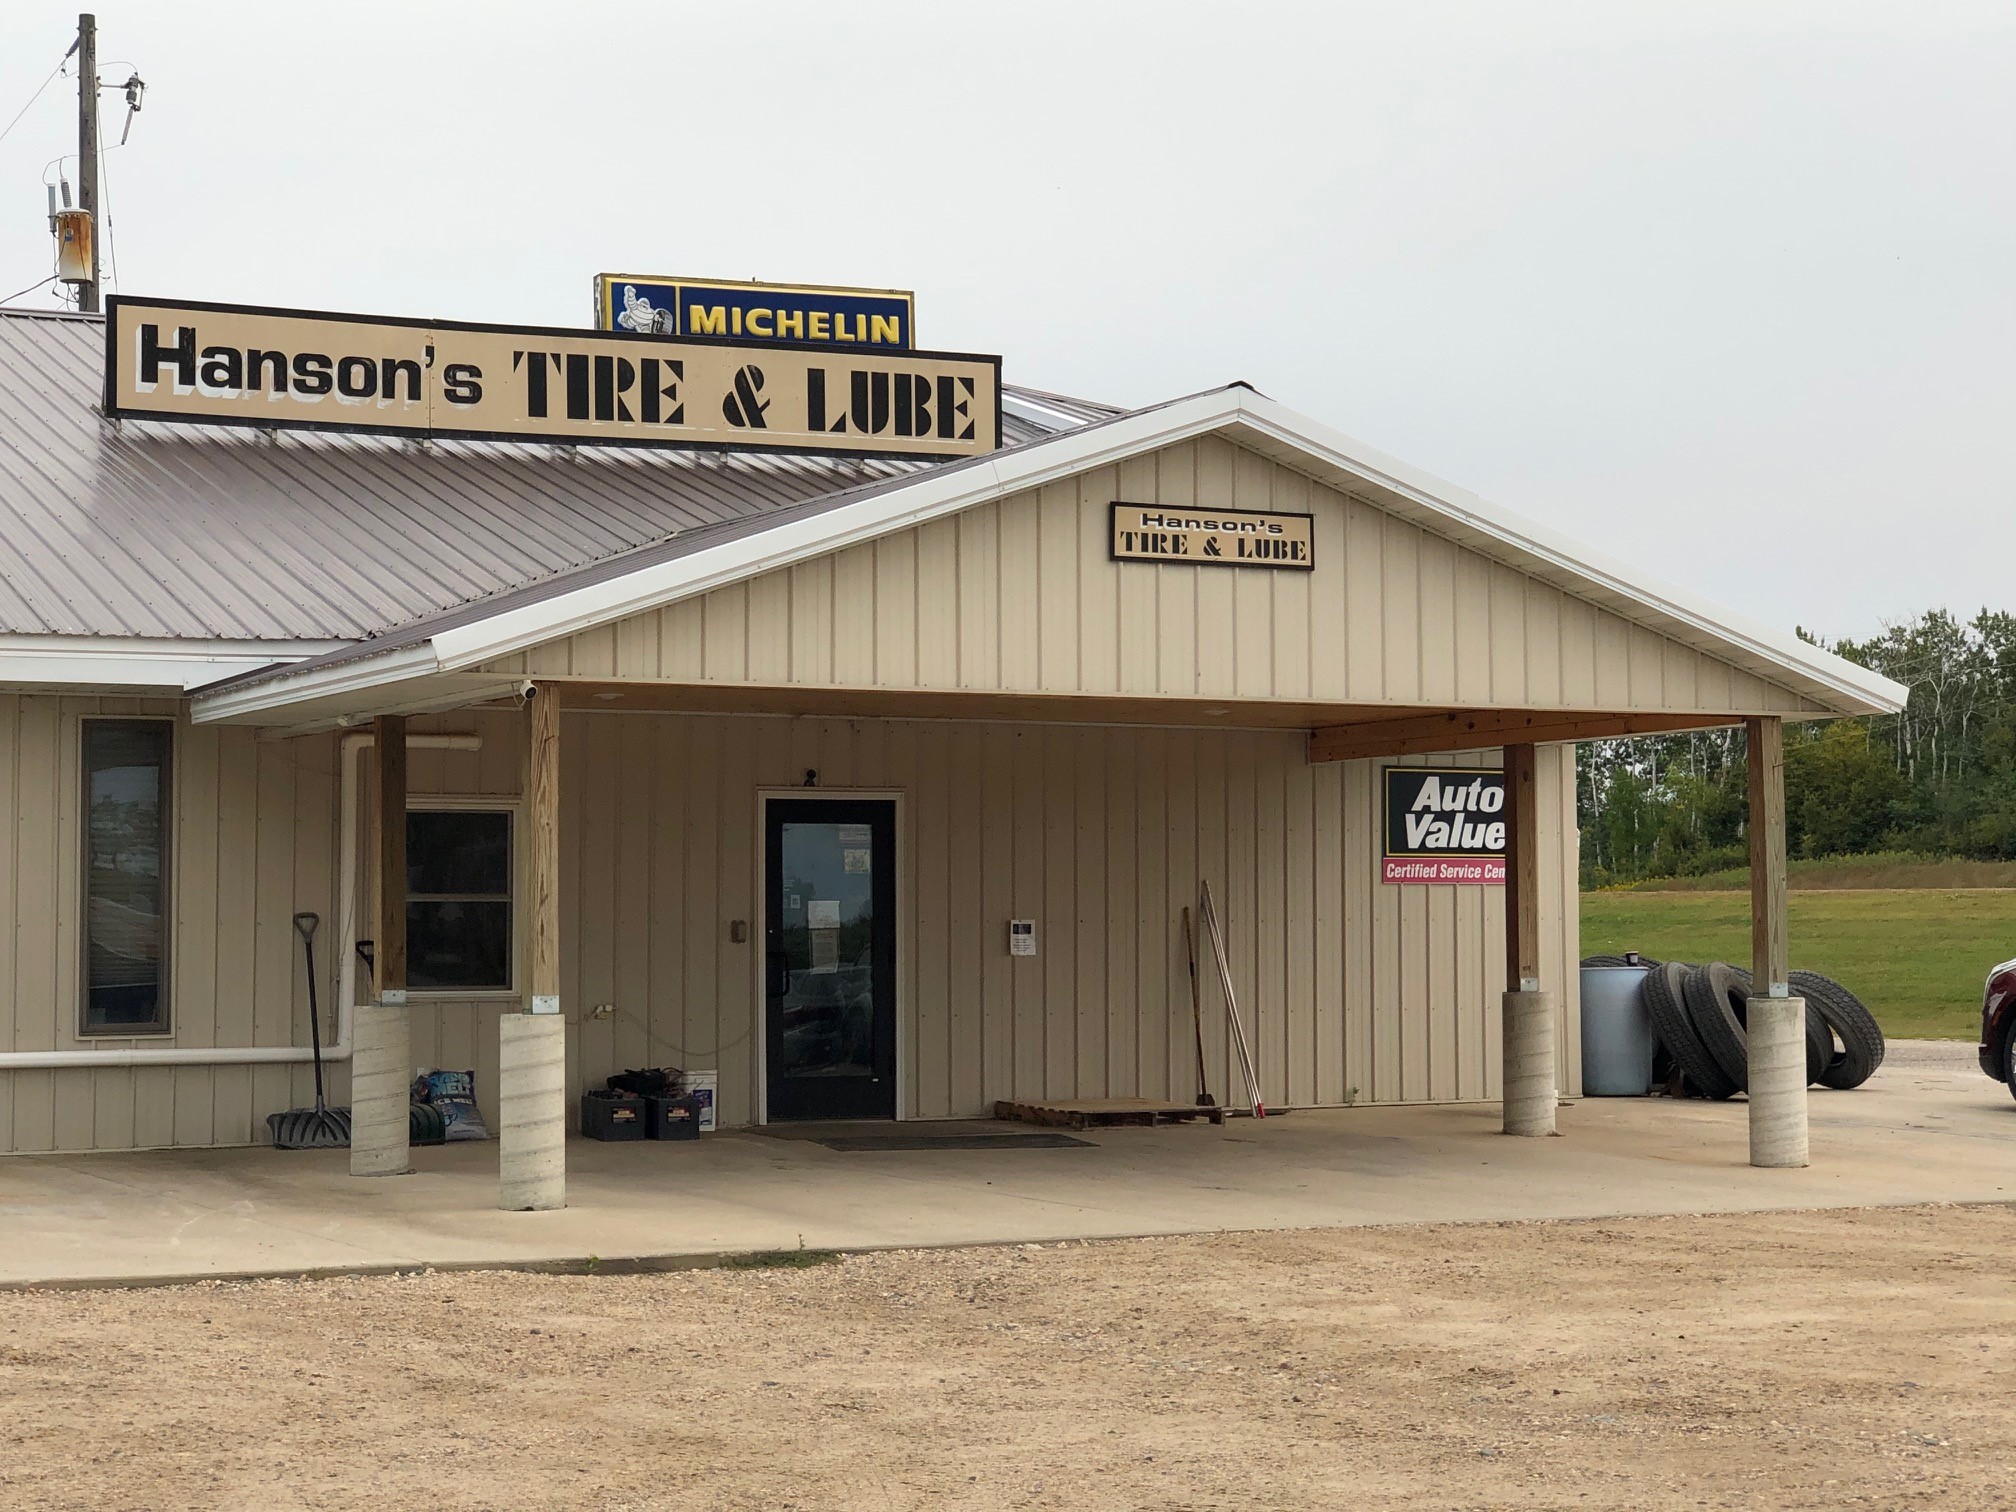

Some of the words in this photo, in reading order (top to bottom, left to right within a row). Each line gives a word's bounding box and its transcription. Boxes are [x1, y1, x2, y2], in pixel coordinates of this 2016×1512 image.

[690, 305, 899, 344] MICHELIN
[137, 324, 483, 408] Hanson's
[513, 351, 683, 424] TIRE
[722, 364, 770, 428] &
[807, 368, 974, 439] LUBE
[1141, 513, 1283, 535] Hanson's
[1120, 531, 1187, 554] TIRE
[1203, 536, 1221, 556] &
[1238, 538, 1306, 560] LUBE
[1411, 776, 1504, 813] Auto
[1405, 813, 1505, 850] Value
[1386, 863, 1437, 878] Certified
[1440, 864, 1481, 878] Service
